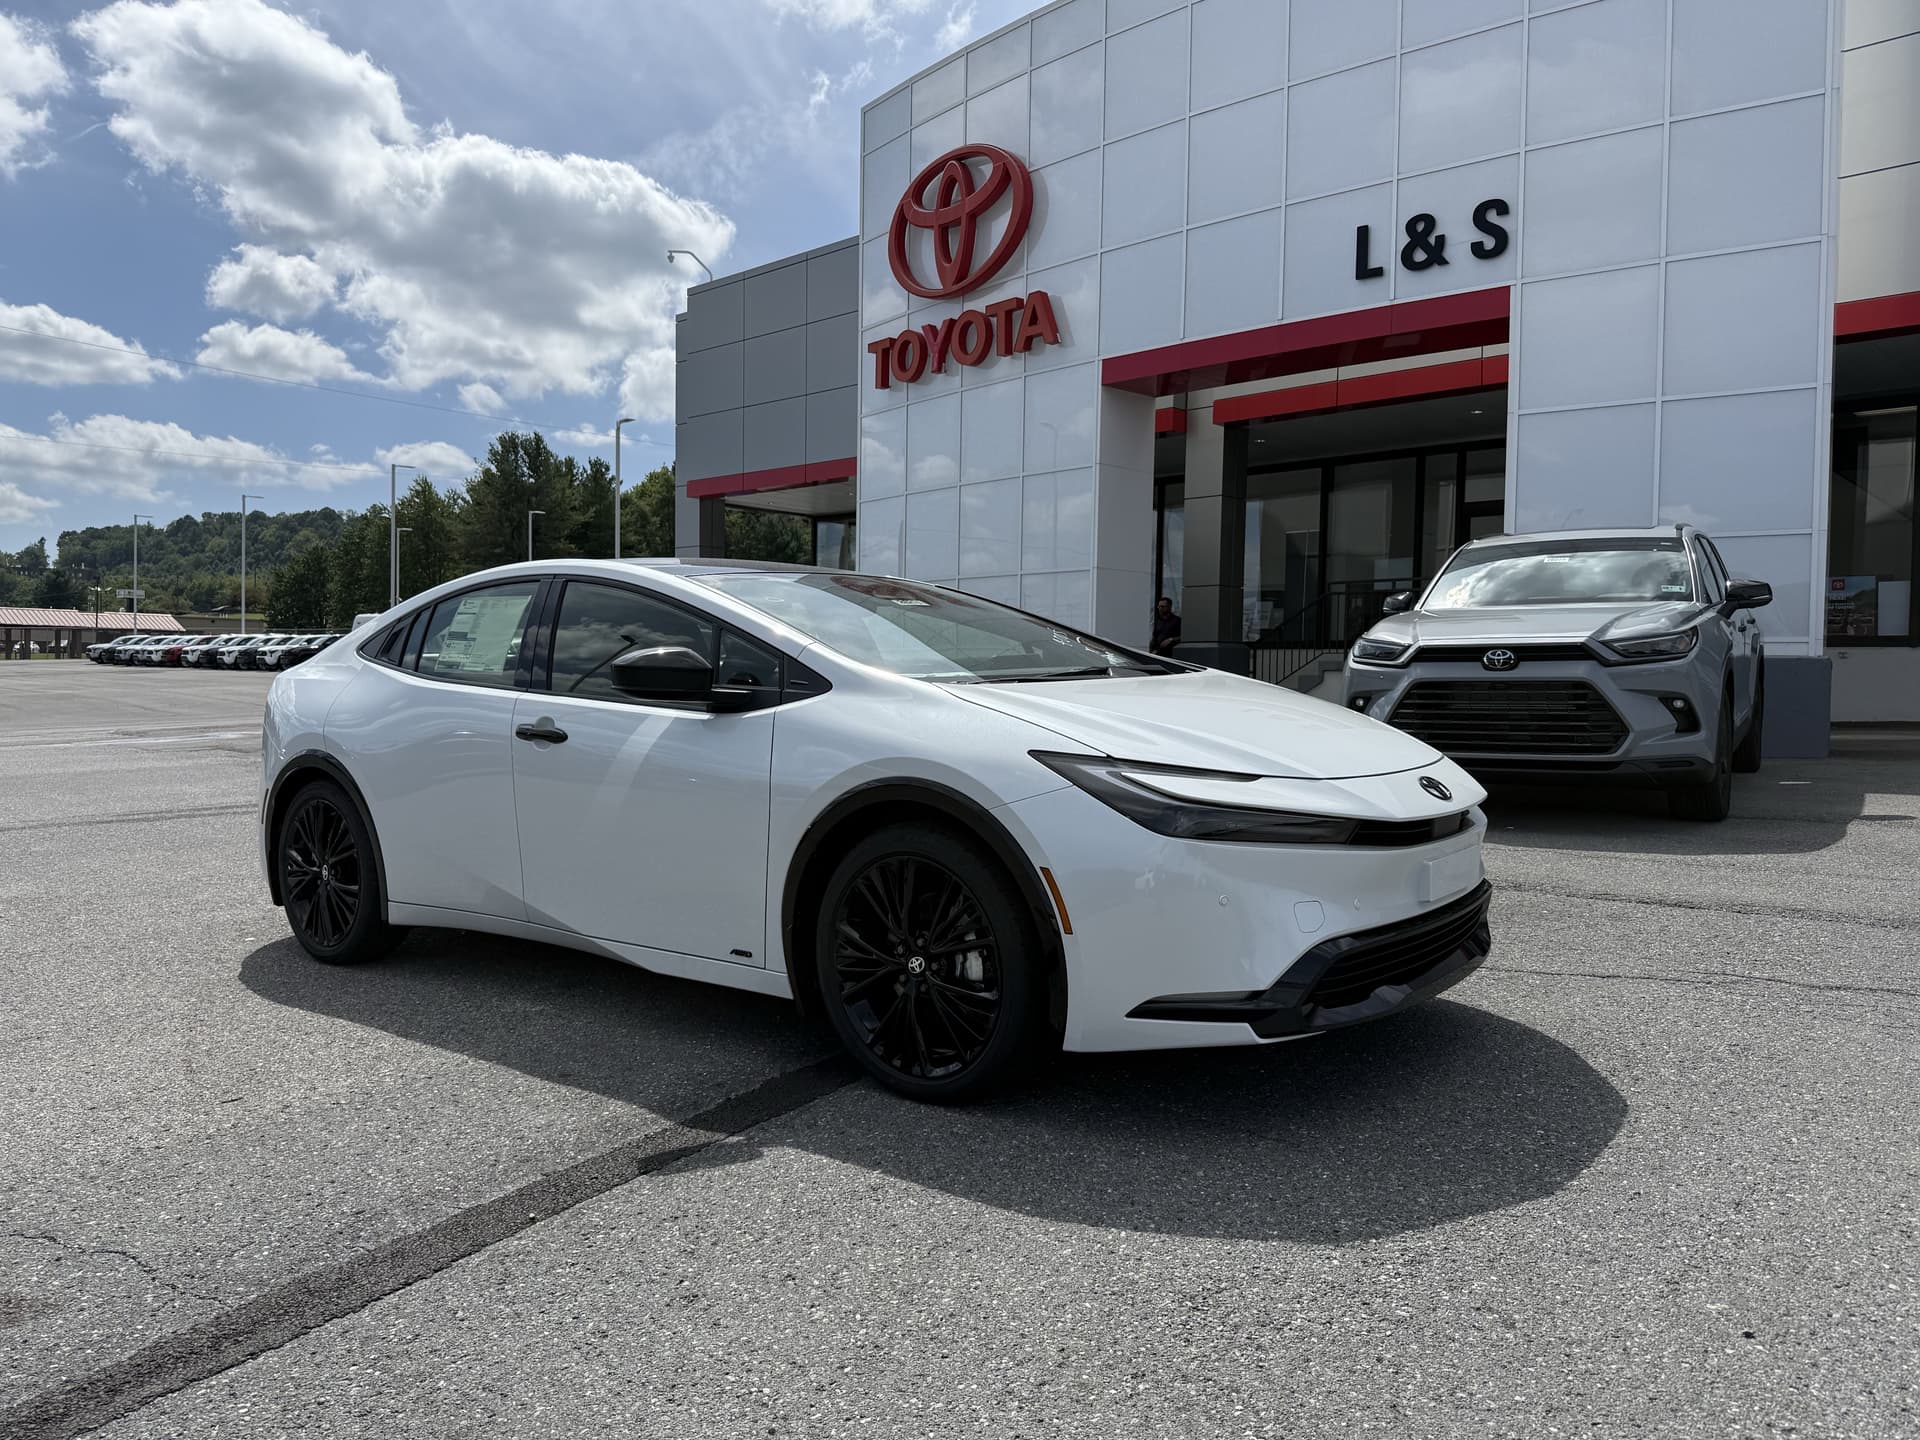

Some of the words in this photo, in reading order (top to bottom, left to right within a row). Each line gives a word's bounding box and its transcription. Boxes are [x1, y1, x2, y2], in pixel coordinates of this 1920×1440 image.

[1355, 224, 1384, 280] L
[1400, 213, 1450, 271] &
[1470, 198, 1510, 260] S
[868, 290, 1060, 389] TOYOTA
